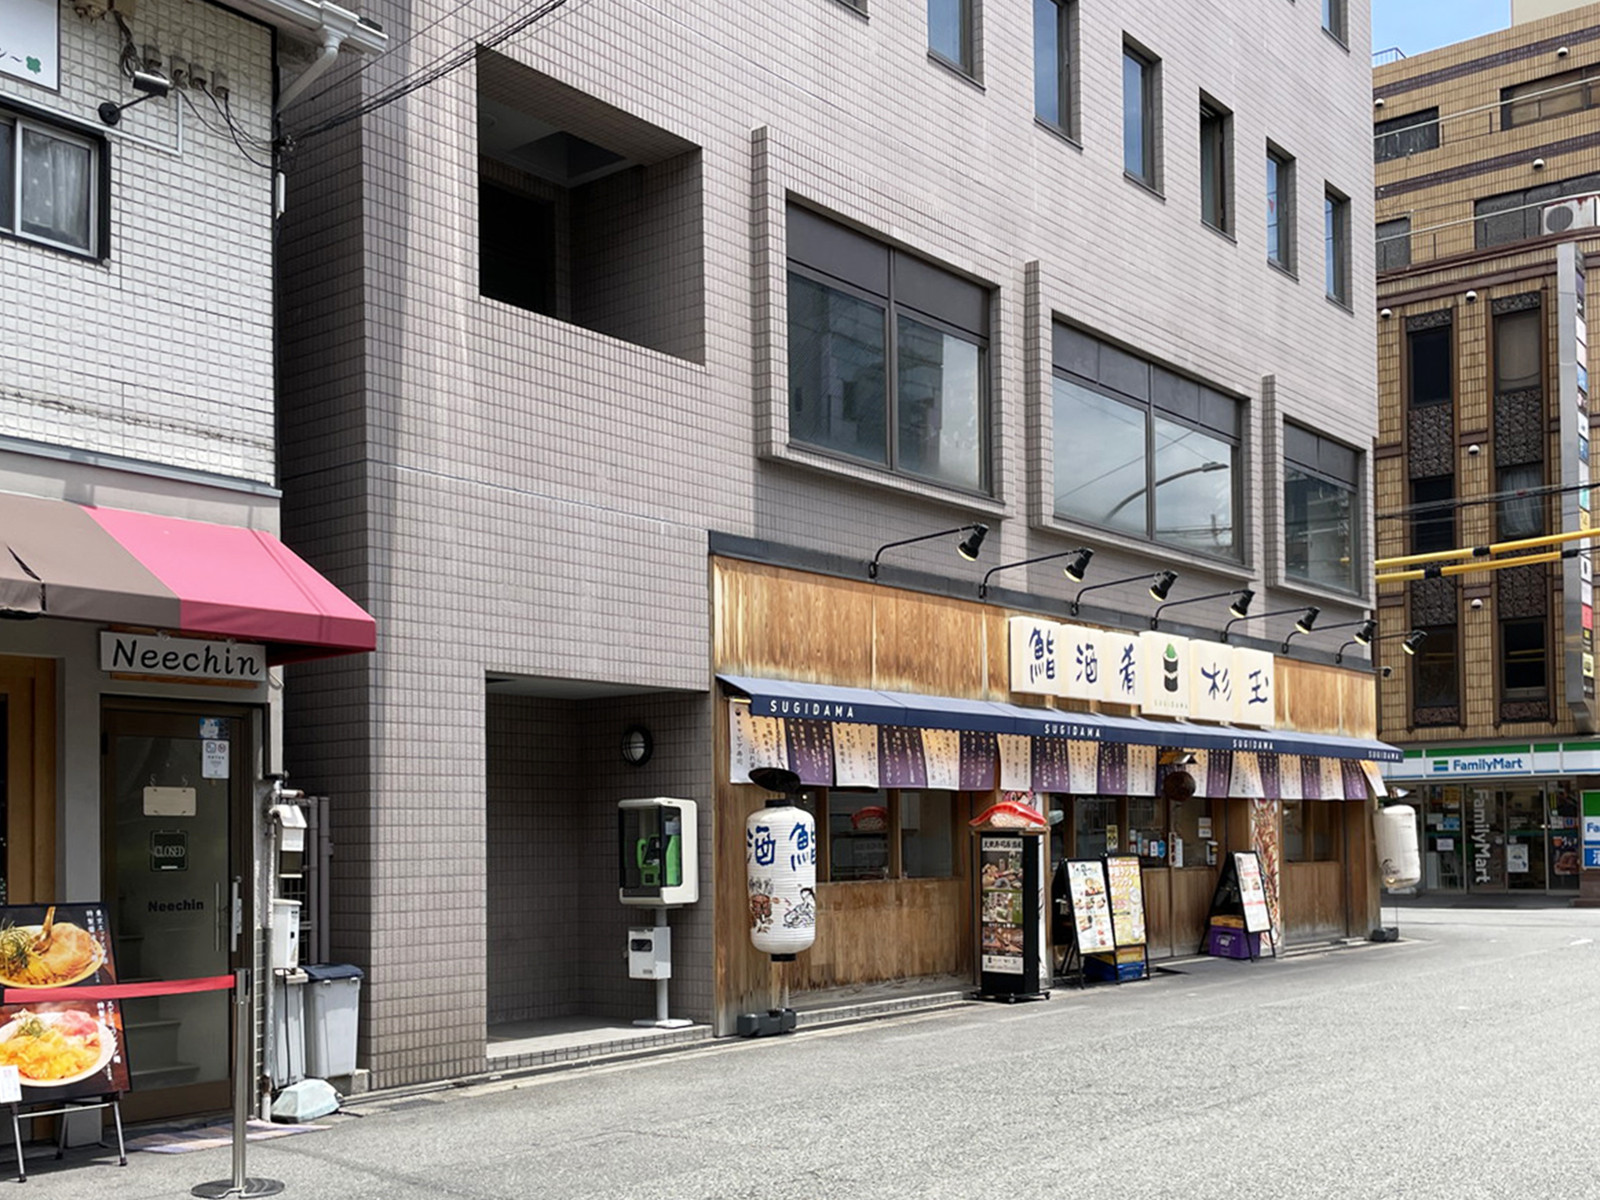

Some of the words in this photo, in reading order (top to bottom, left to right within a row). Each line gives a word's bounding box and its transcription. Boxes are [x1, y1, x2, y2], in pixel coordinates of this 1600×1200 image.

[112, 638, 260, 676] Neechin
[1200, 662, 1270, 706] 杉玉
[770, 699, 854, 718] SUGIDAMA
[1044, 722, 1101, 738] SUGIDAMA
[1232, 739, 1274, 751] SUGIDAMA
[1368, 750, 1399, 760] SUGIDAMA
[1453, 757, 1523, 772] FamilyMart
[1471, 789, 1492, 883] FamilyMart
[153, 845, 186, 858] CLOSED
[147, 898, 204, 913] Neechin
